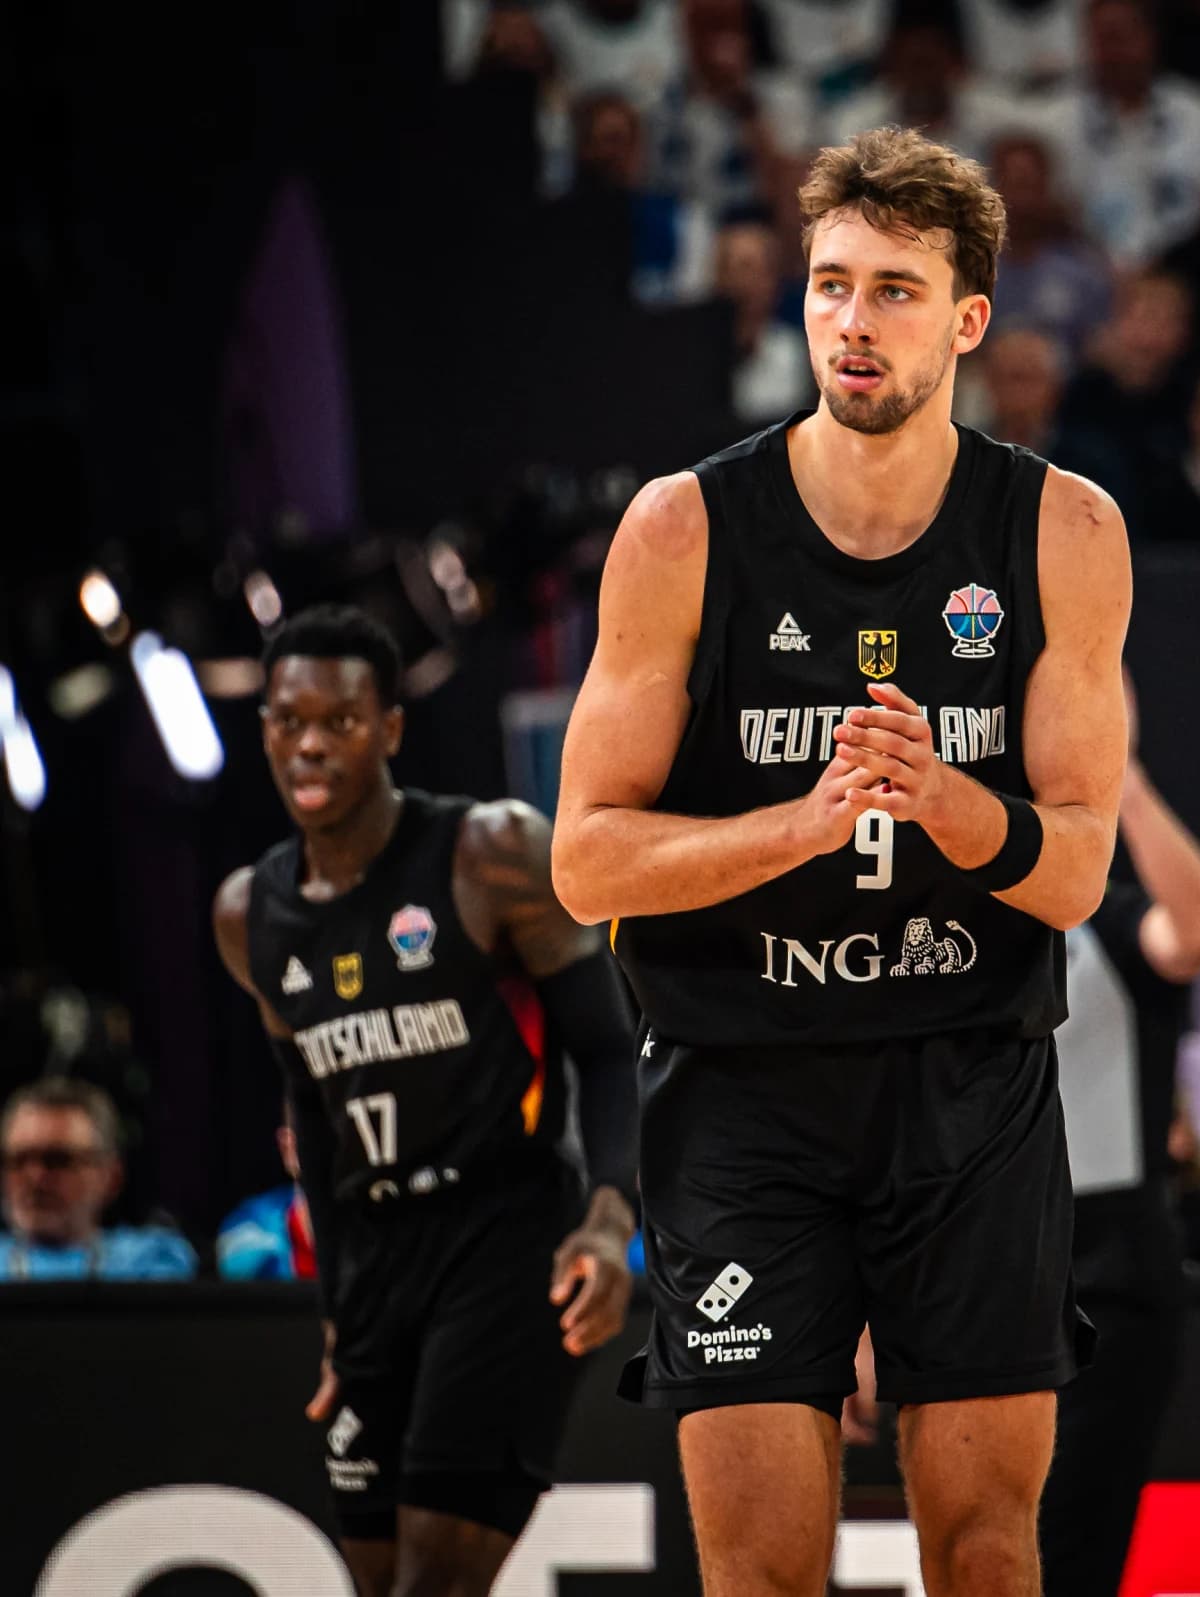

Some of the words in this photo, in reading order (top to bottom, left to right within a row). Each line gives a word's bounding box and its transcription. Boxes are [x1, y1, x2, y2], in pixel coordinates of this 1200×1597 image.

[769, 634, 811, 651] PEAK
[855, 808, 894, 890] 9
[760, 932, 885, 987] ING
[346, 1092, 397, 1166] 17
[687, 1323, 773, 1348] Domino's
[704, 1346, 757, 1364] Pizza
